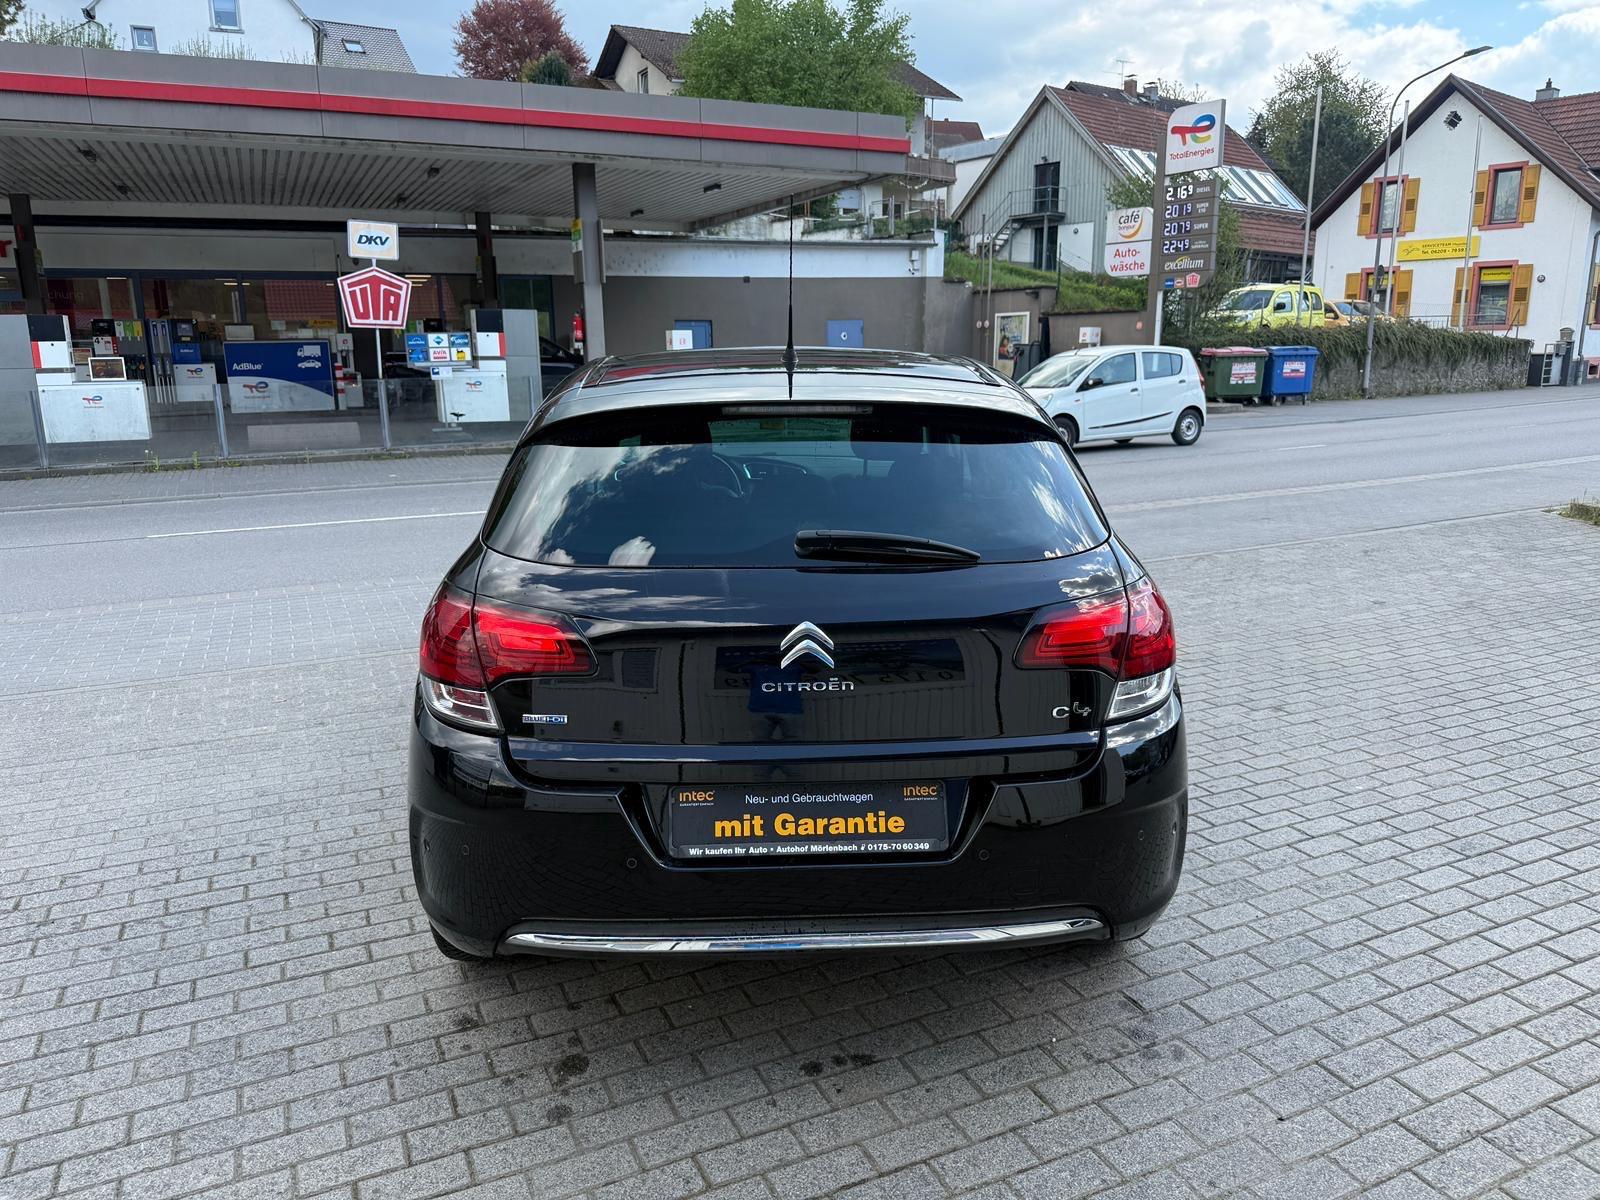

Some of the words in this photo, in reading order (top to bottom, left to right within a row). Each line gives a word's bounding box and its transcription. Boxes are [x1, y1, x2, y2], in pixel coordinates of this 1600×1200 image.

[1169, 147, 1215, 160] TotalEnergies
[1118, 210, 1140, 225] café
[357, 234, 389, 246] DKV
[1113, 248, 1140, 258] Auto-
[1110, 260, 1145, 272] wäsche
[347, 275, 404, 321] UTA
[232, 362, 264, 371] AdBlue
[745, 794, 769, 805] Neu-
[771, 794, 790, 804] und
[791, 792, 874, 805] Gebrauchtwagen
[714, 814, 764, 838] mit
[774, 811, 905, 836] Garantie
[689, 847, 704, 856] Wir
[705, 846, 733, 855] kaufen
[734, 846, 747, 854] Ihr
[748, 846, 768, 855] Auto
[776, 844, 809, 853] Autohof
[810, 843, 858, 853] Mörlenbach
